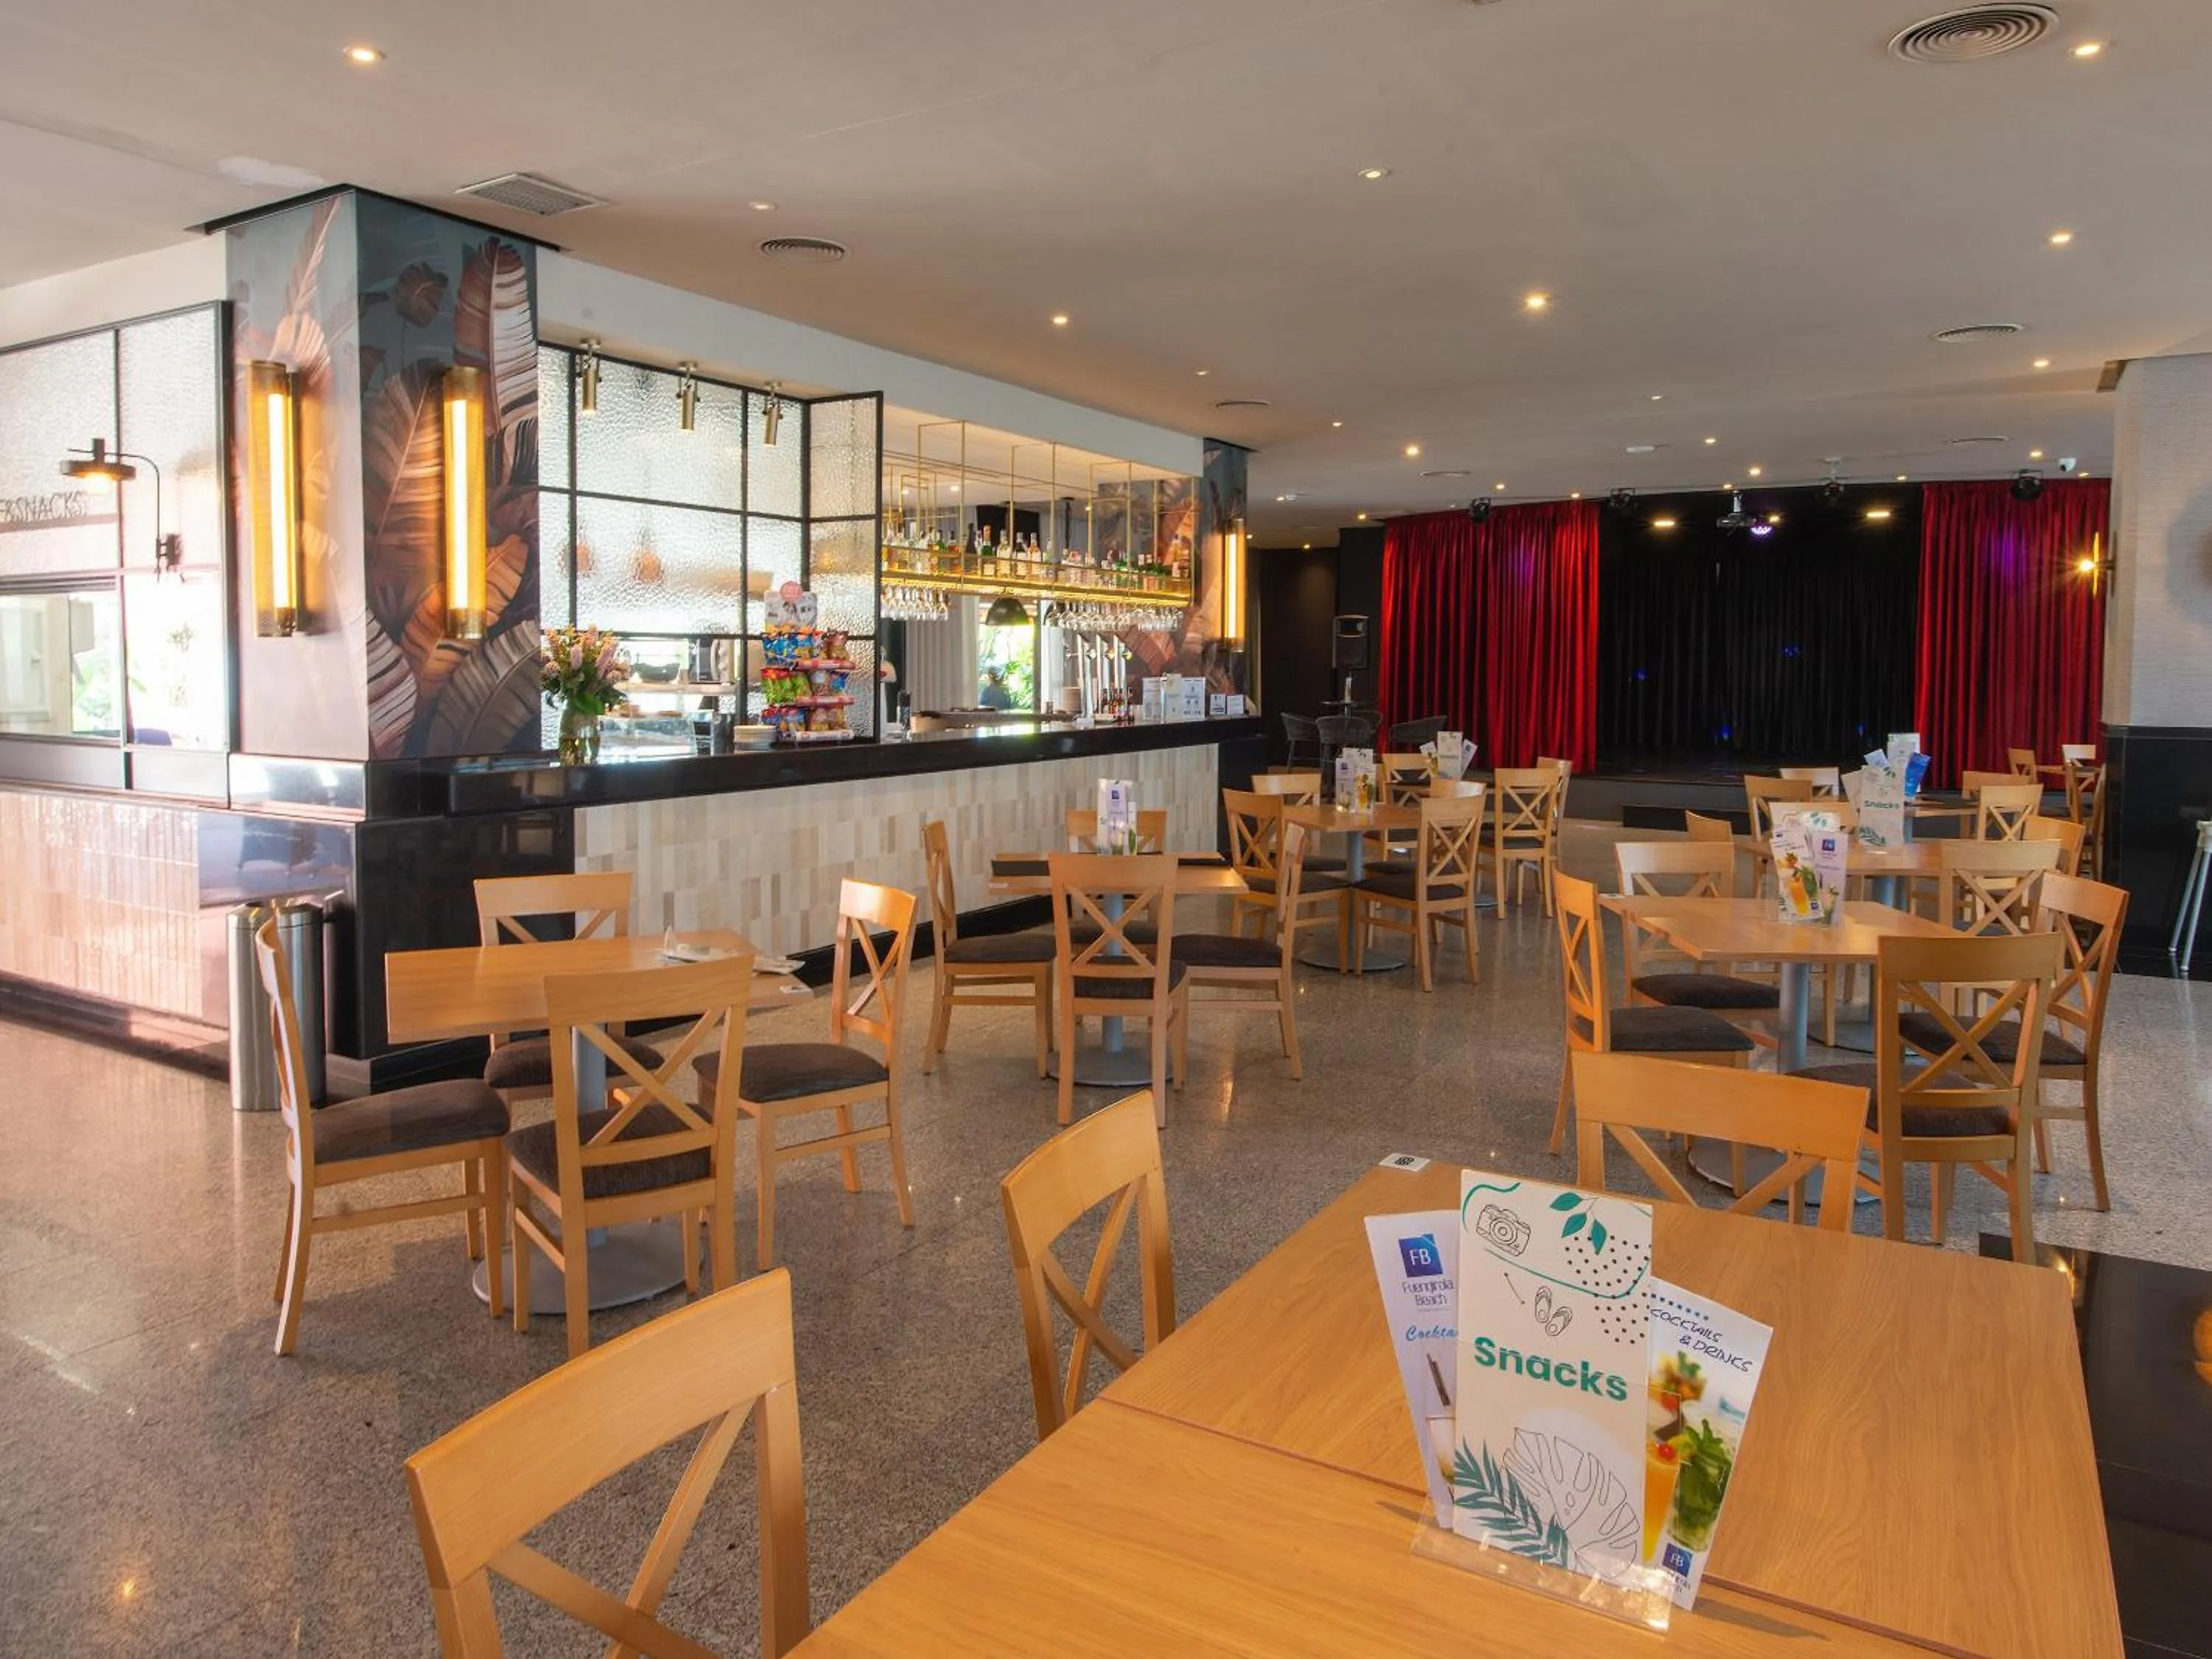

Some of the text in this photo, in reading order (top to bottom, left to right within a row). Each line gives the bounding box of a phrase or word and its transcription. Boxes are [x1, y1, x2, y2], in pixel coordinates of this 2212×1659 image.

[1409, 1248, 1431, 1265] FB
[1415, 1294, 1447, 1307] Beach
[1405, 1324, 1458, 1341] Cockta
[1650, 1309, 1722, 1343] COCKTAILS
[1679, 1335, 1753, 1372] & DRINKS
[1475, 1336, 1627, 1401] Snacks
